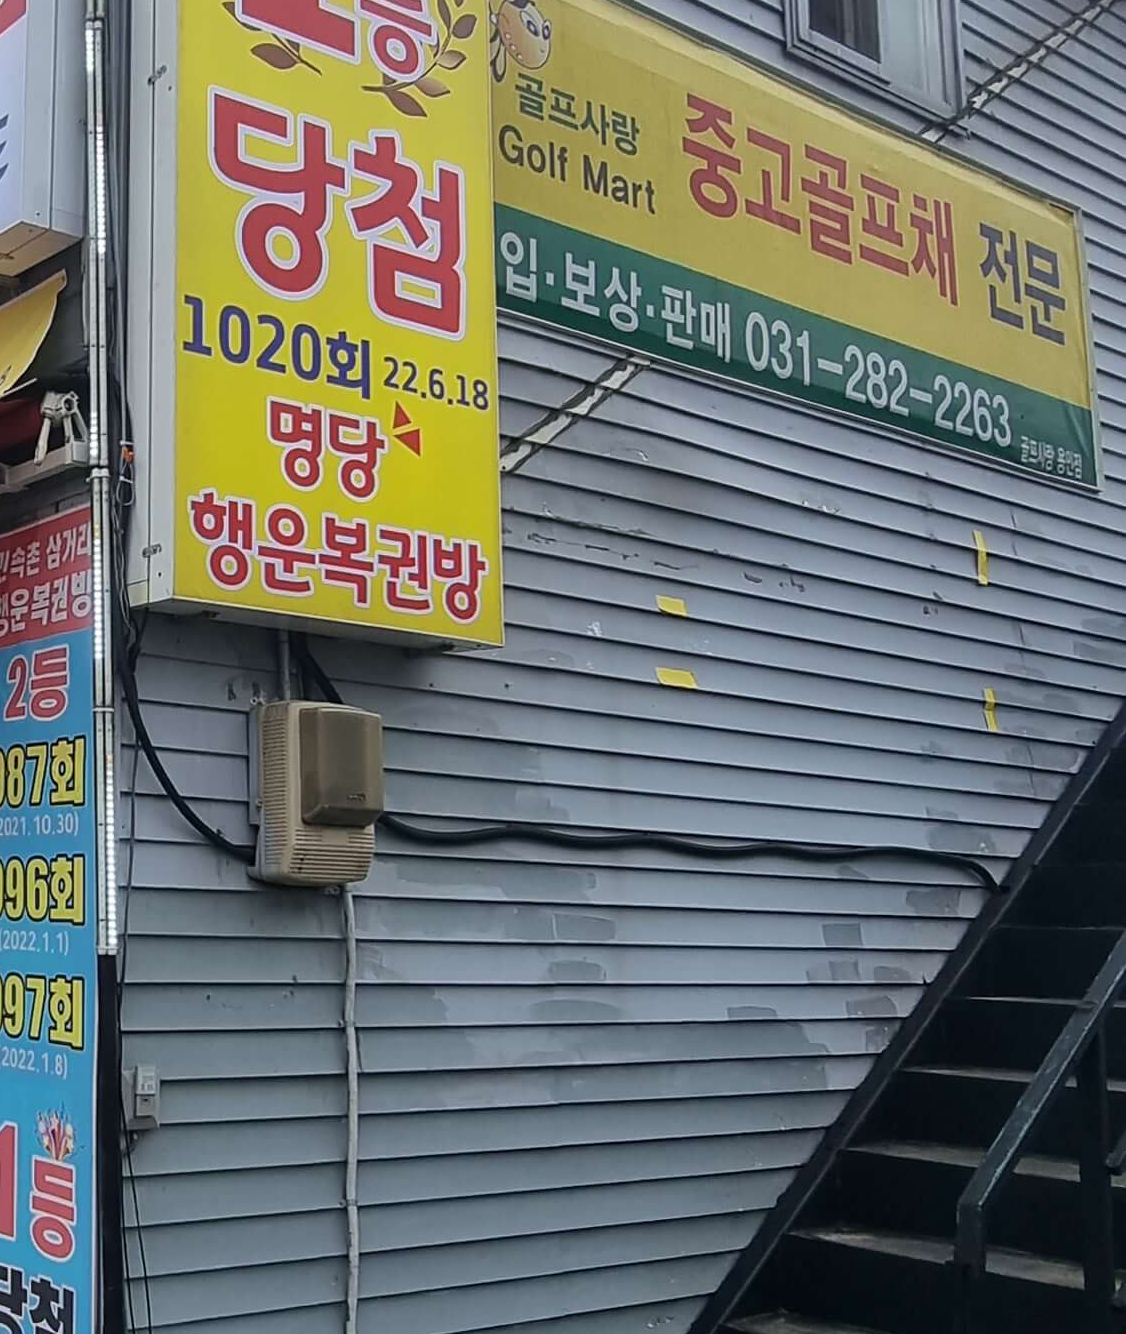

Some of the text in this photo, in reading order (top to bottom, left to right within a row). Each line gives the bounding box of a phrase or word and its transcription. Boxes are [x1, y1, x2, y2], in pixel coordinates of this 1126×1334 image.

[497, 122, 657, 215] Golf Mart
[514, 72, 640, 156] 골프사랑
[206, 83, 467, 343] 당첨
[681, 91, 1067, 347] 중고골프채 전문
[182, 293, 490, 413] 1020회 22.6.18
[744, 311, 1013, 449] 031-282-2263
[267, 395, 386, 501] 명당
[187, 487, 488, 625] 행운복권방
[3, 643, 72, 723] 2등
